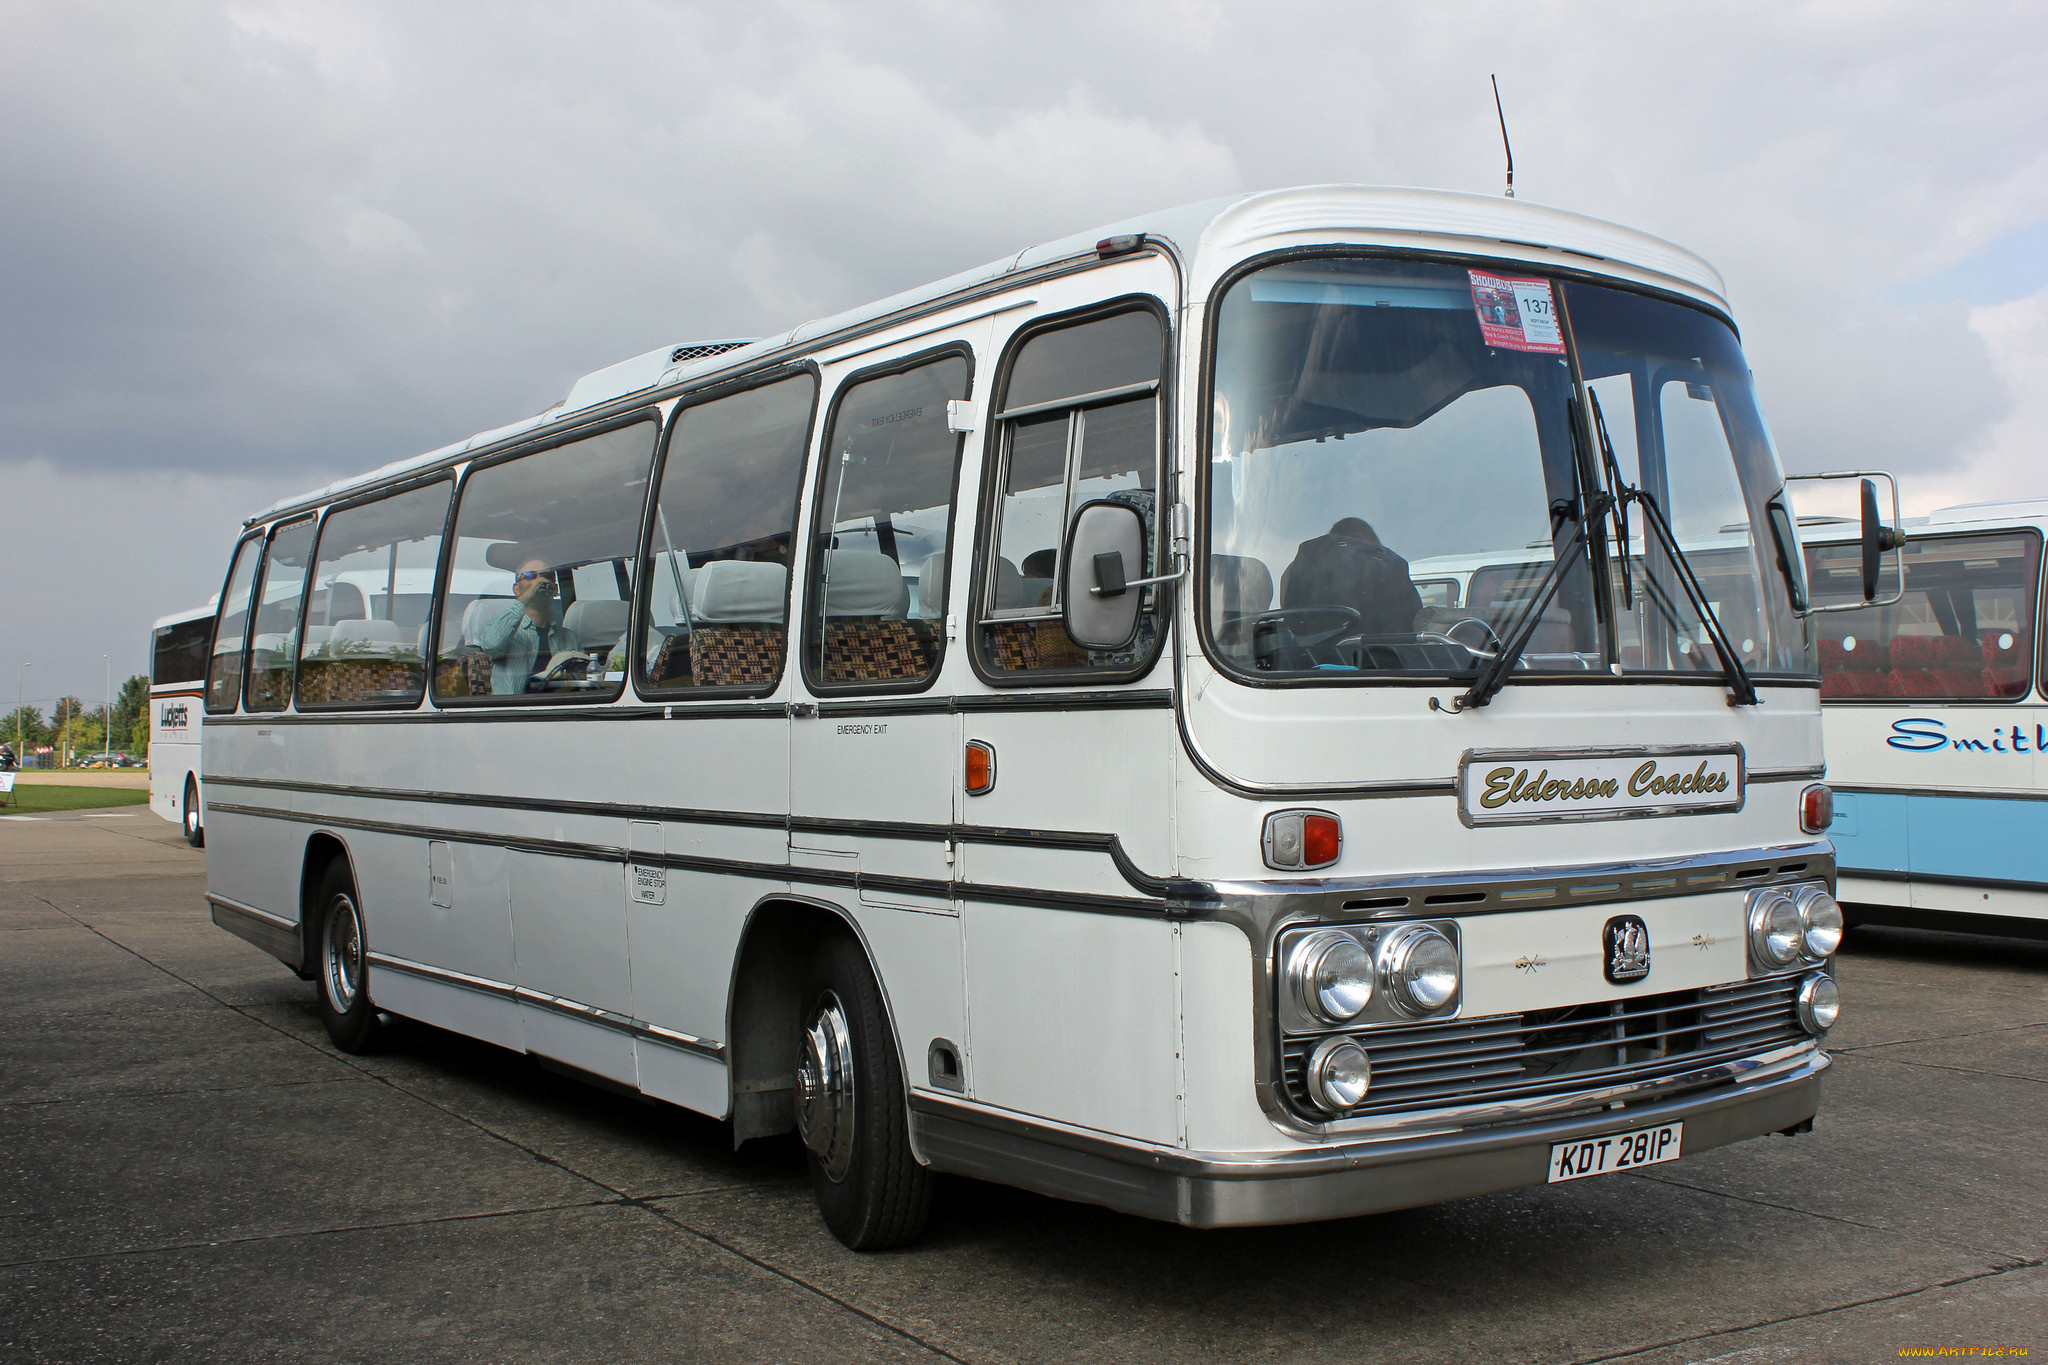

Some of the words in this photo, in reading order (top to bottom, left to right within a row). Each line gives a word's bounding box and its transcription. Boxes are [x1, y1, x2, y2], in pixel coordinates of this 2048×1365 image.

[1471, 273, 1512, 292] SHOWBUS
[1523, 298, 1549, 315] 137
[837, 724, 872, 735] EMERGENCY
[873, 724, 887, 734] EXIT
[1480, 766, 1619, 808] Elderson
[1627, 760, 1729, 797] Coaches
[638, 867, 663, 879] EMERGENCY
[637, 877, 653, 887] ENGINE
[641, 890, 655, 899] WATER
[1559, 1140, 1612, 1177] KDT
[1616, 1128, 1672, 1167] 281P
